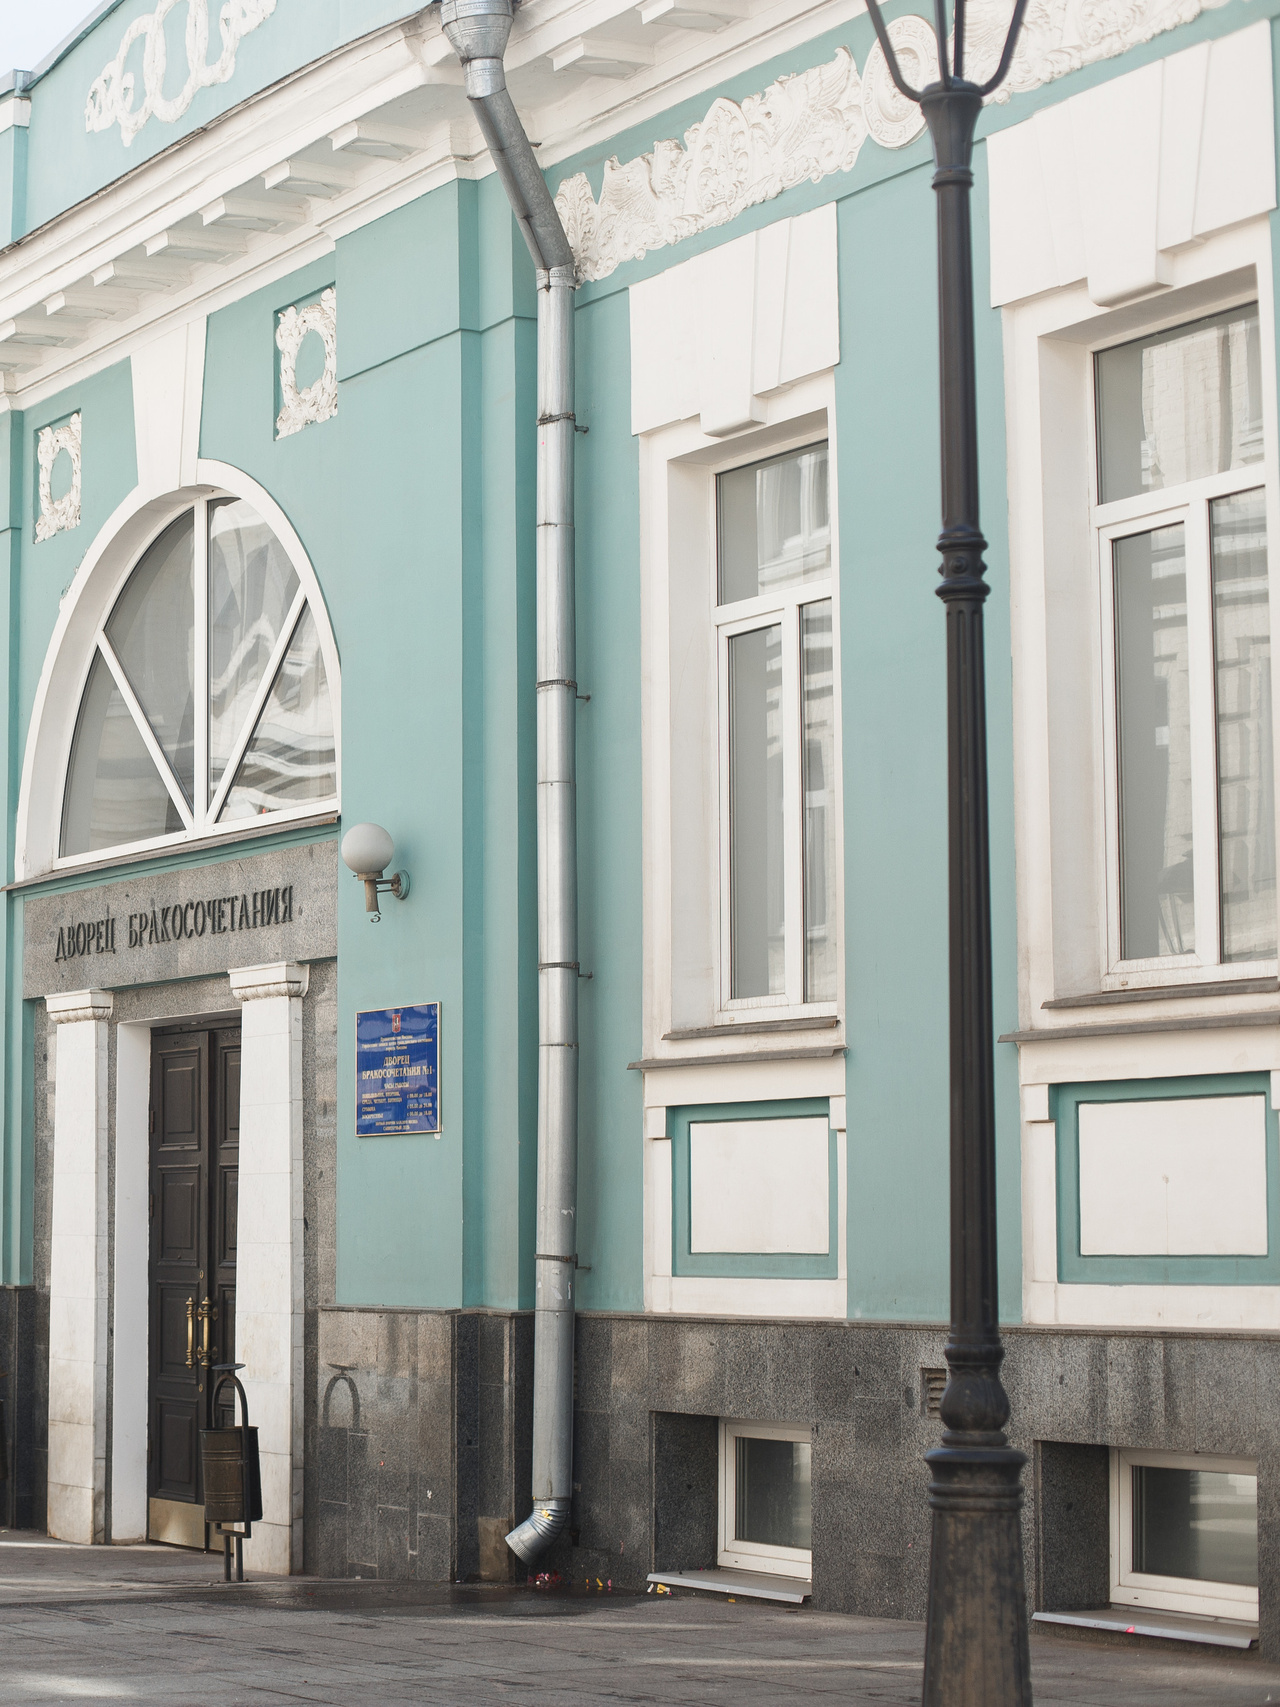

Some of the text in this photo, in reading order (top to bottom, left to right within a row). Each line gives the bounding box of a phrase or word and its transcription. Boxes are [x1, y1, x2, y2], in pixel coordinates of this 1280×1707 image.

[55, 885, 294, 963] ДВОРЕЦ БРАКОСОЧЕТАНИЯ
[383, 1054, 410, 1067] ДВОРЕЦ
[362, 1065, 421, 1080] БРАКОСОЧЕТАНИЯ
